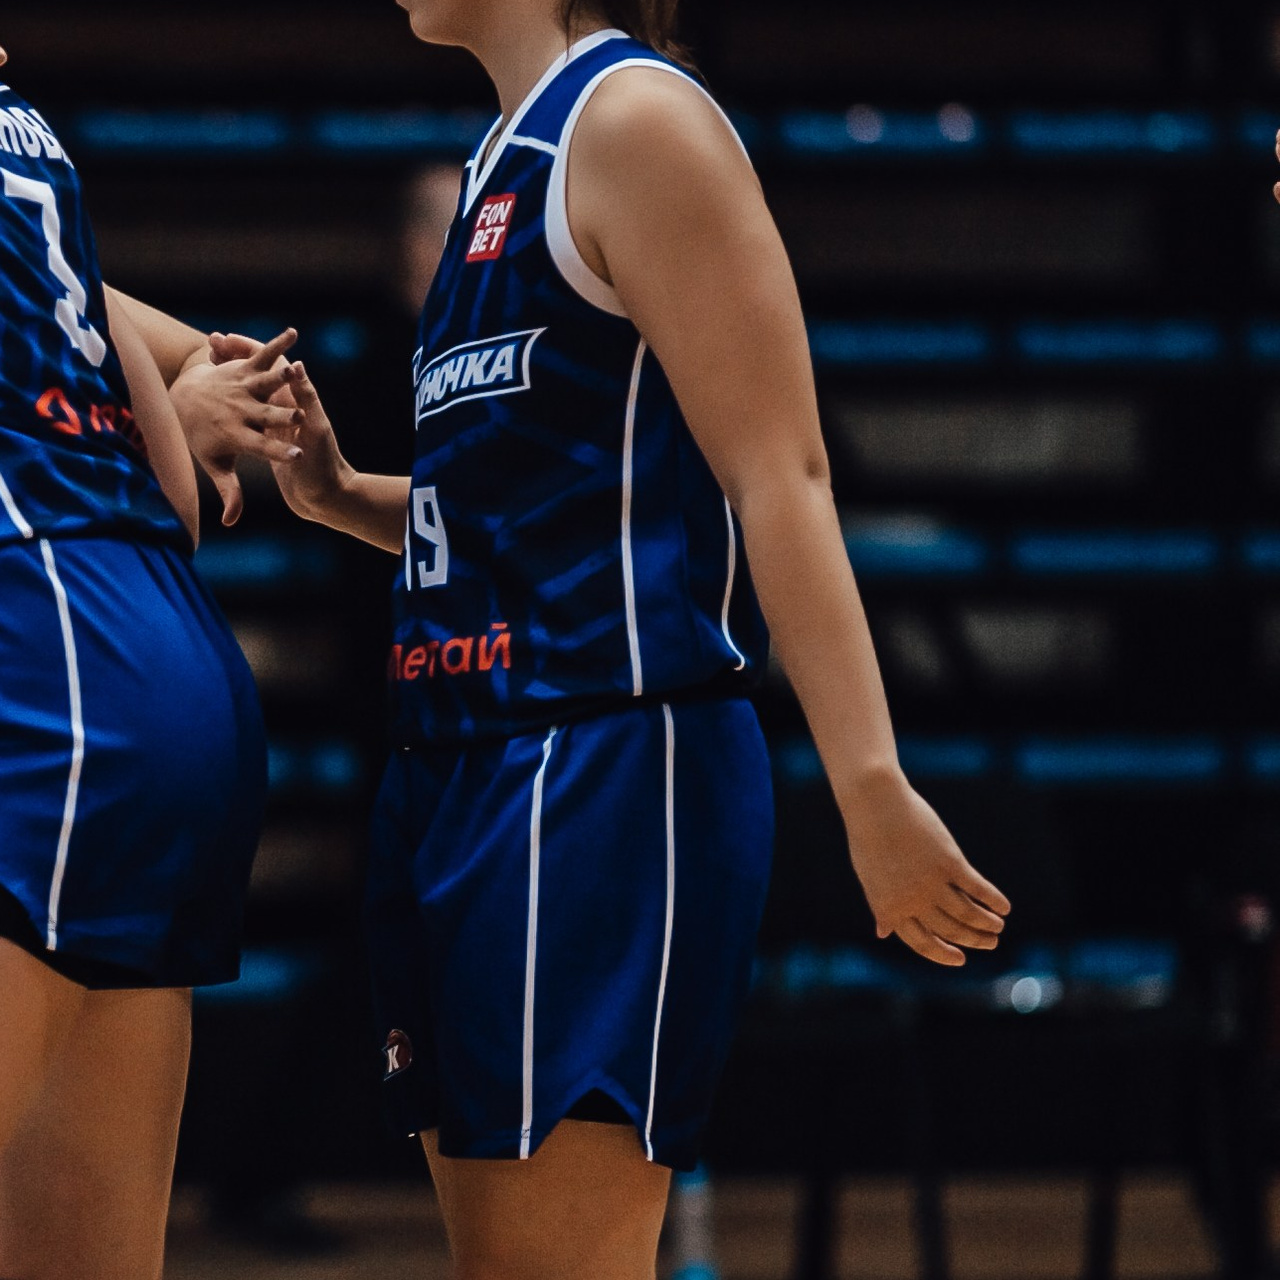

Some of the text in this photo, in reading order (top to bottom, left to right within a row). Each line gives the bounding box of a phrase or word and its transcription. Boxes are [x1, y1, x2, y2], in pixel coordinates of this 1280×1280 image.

[476, 200, 513, 229] FON
[468, 226, 506, 255] BET
[419, 344, 517, 410] НОЧКА
